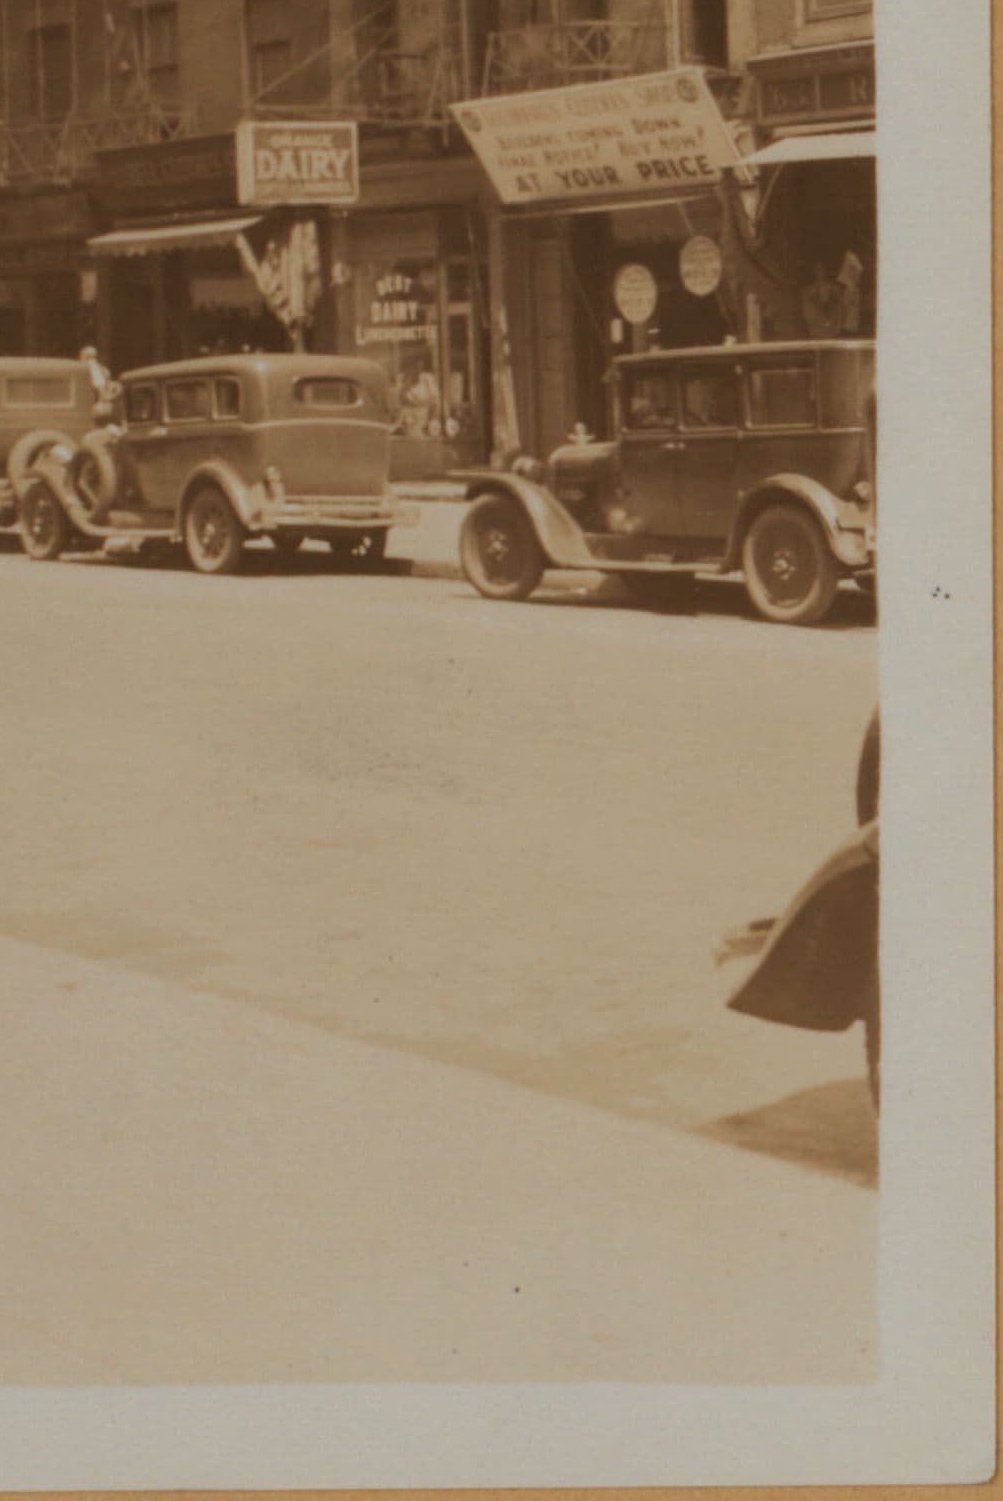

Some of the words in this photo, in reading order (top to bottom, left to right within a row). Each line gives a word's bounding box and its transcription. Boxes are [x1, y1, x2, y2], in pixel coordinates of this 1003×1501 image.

[255, 148, 350, 180] DAIRY
[515, 172, 541, 194] AT
[556, 165, 622, 189] YOUR
[635, 153, 716, 181] PRICE
[371, 300, 417, 323] DAIRY
